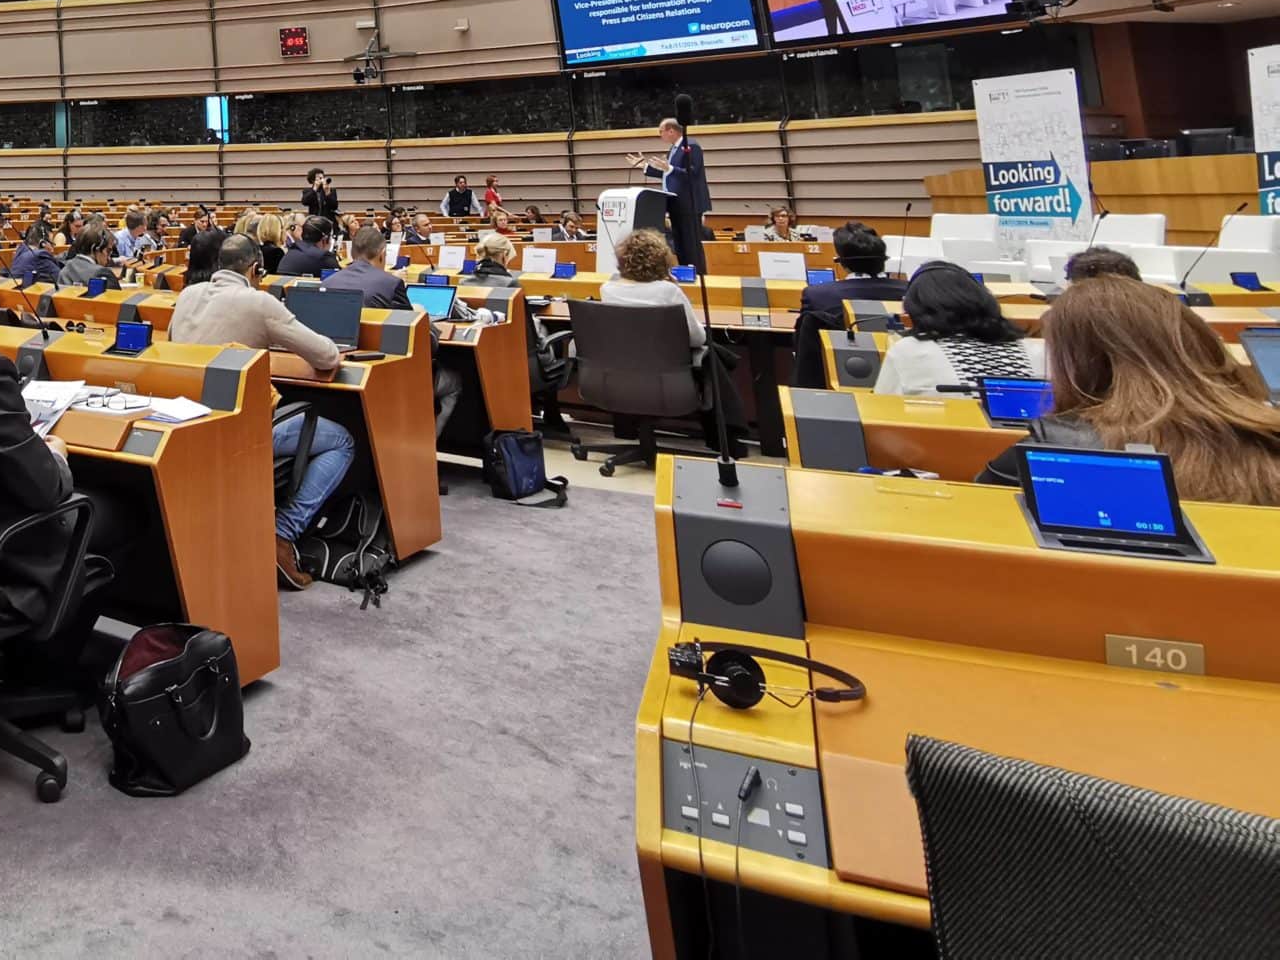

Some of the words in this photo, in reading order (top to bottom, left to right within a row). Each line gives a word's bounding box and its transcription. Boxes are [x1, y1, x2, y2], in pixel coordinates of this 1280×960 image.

[589, 5, 628, 19] responsible
[630, 3, 640, 12] for
[602, 16, 620, 26] Press
[621, 14, 635, 23] and
[636, 11, 664, 22] Citizens
[665, 7, 701, 17] Relations
[700, 19, 750, 32] #europcom
[989, 163, 1055, 186] Looking
[993, 188, 1072, 213] forward!
[1125, 644, 1187, 670] 140
